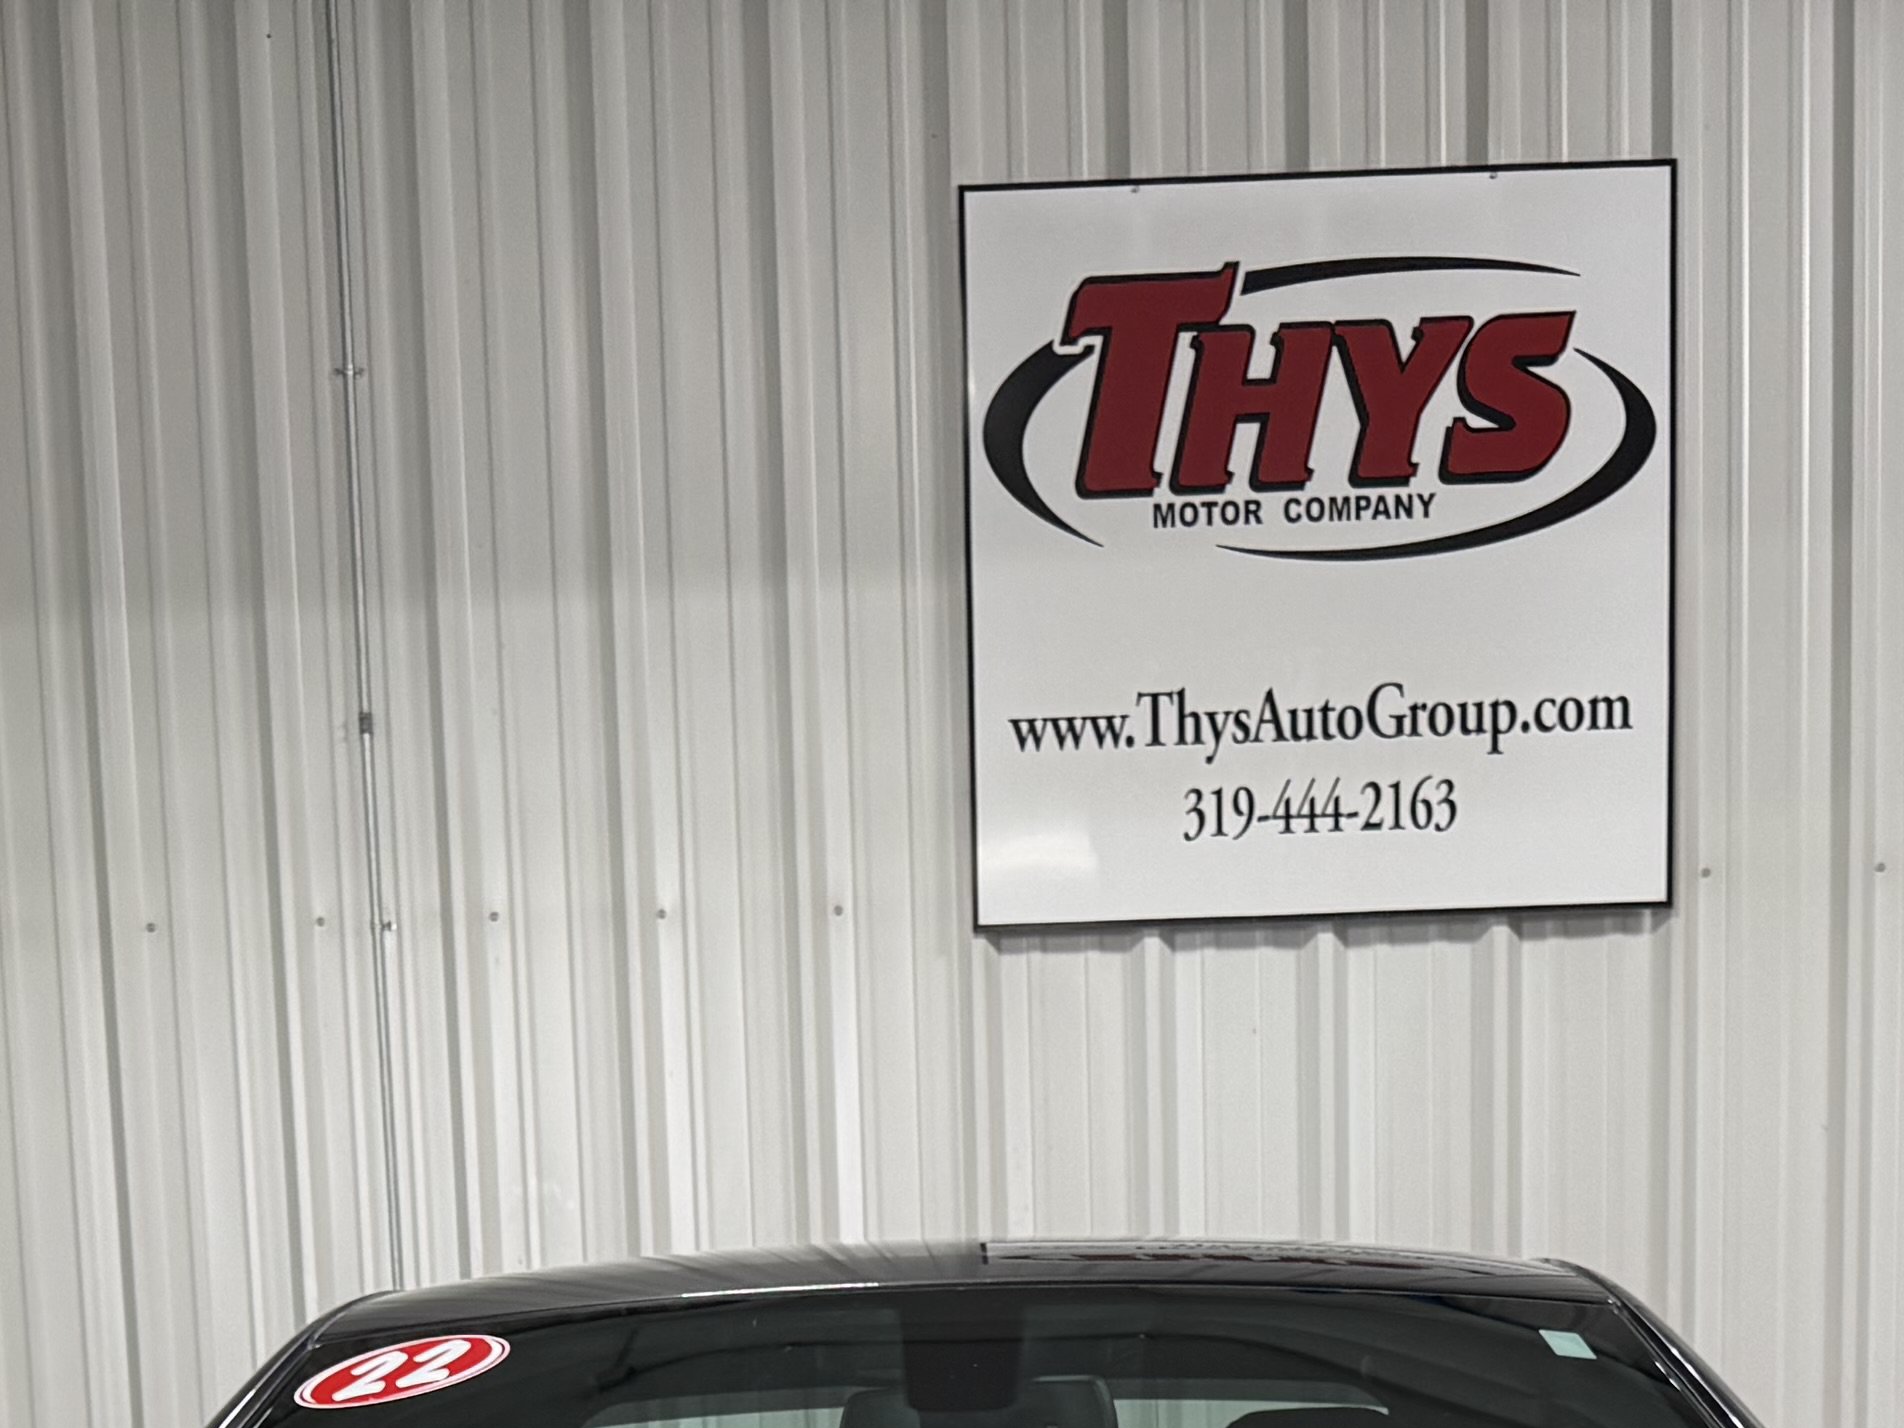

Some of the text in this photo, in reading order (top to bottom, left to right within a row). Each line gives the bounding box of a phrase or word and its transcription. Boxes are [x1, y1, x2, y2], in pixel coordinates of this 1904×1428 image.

[1061, 261, 1576, 499] THYS
[1152, 492, 1437, 529] MOTOR COMPANY
[1008, 681, 1634, 764] www.ThysAutoGroup.com
[1182, 775, 1459, 842] 319-444-2163
[332, 1339, 472, 1402] 22
